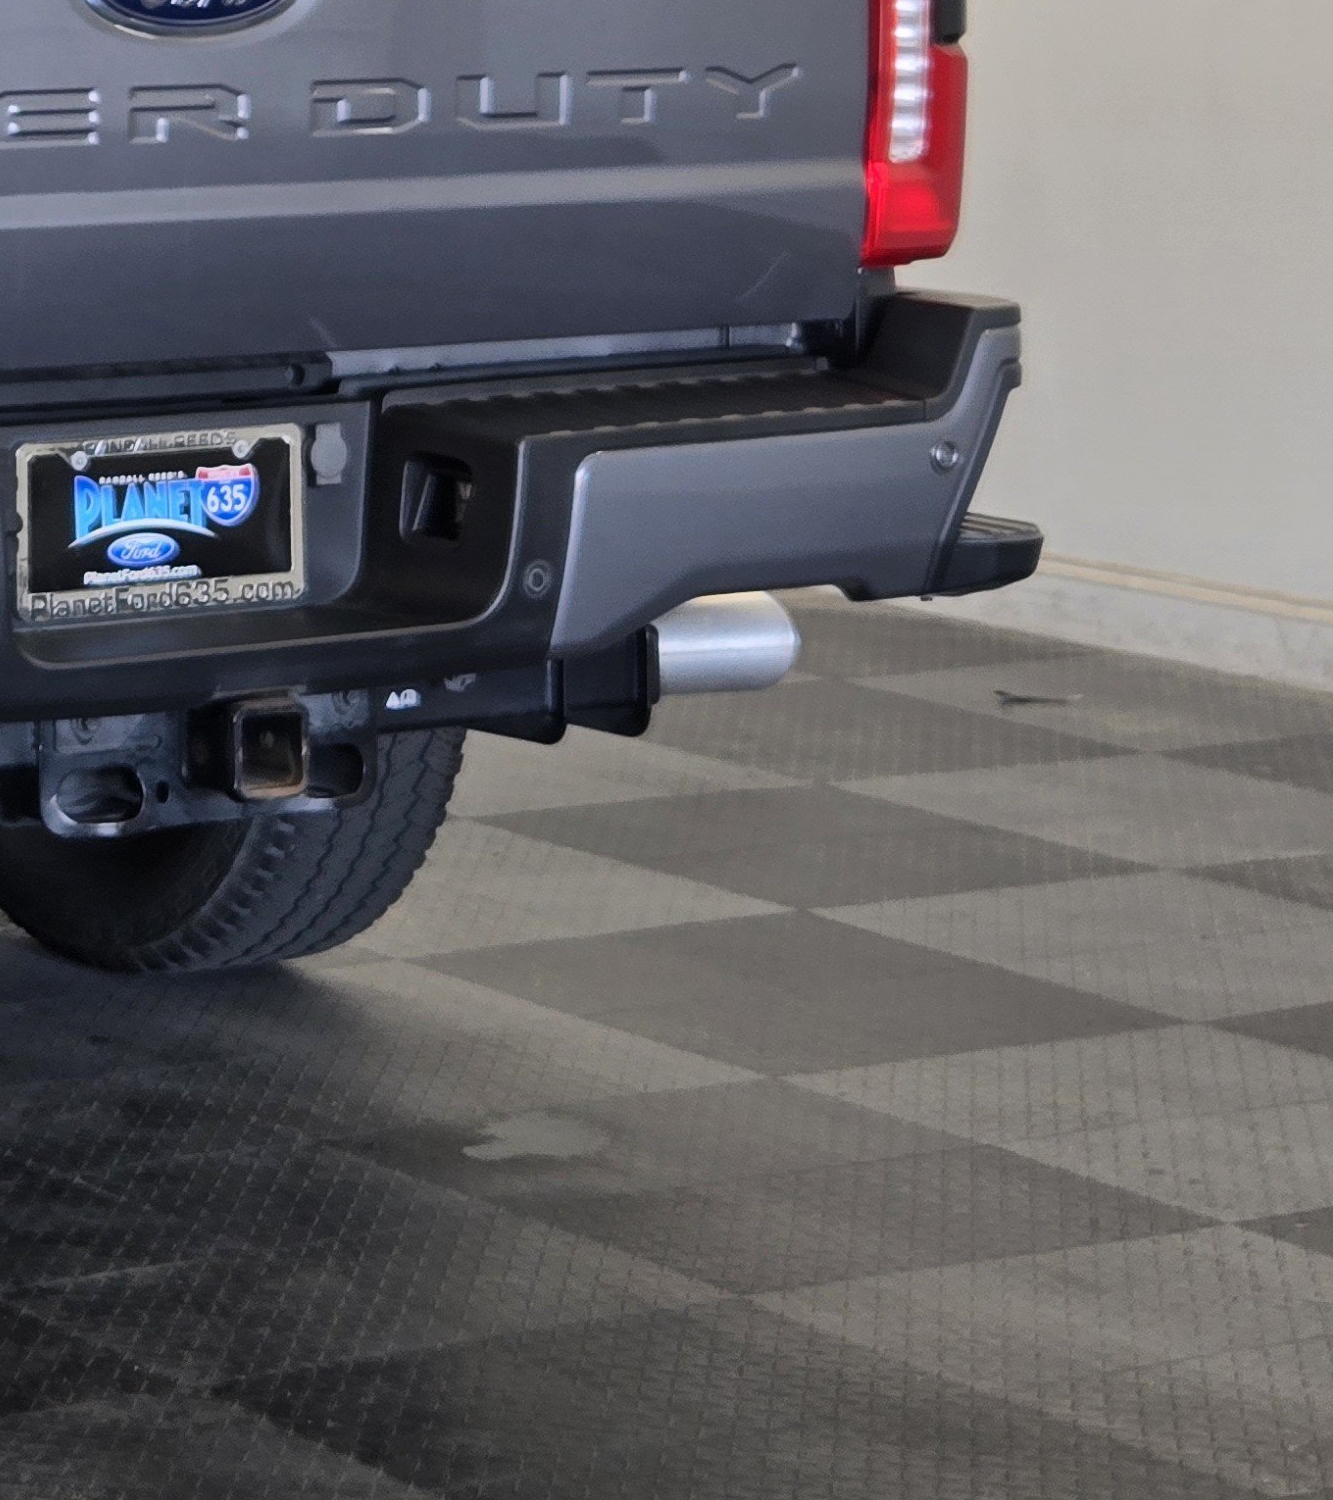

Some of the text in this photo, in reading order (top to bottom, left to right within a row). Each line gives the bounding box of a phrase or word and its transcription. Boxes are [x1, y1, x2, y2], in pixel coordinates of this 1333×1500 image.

[311, 62, 800, 138] DUTY
[74, 475, 206, 541] PLANET
[206, 483, 246, 513] 635
[120, 538, 162, 560] Ford
[33, 577, 298, 619] PlanetFord635.com
